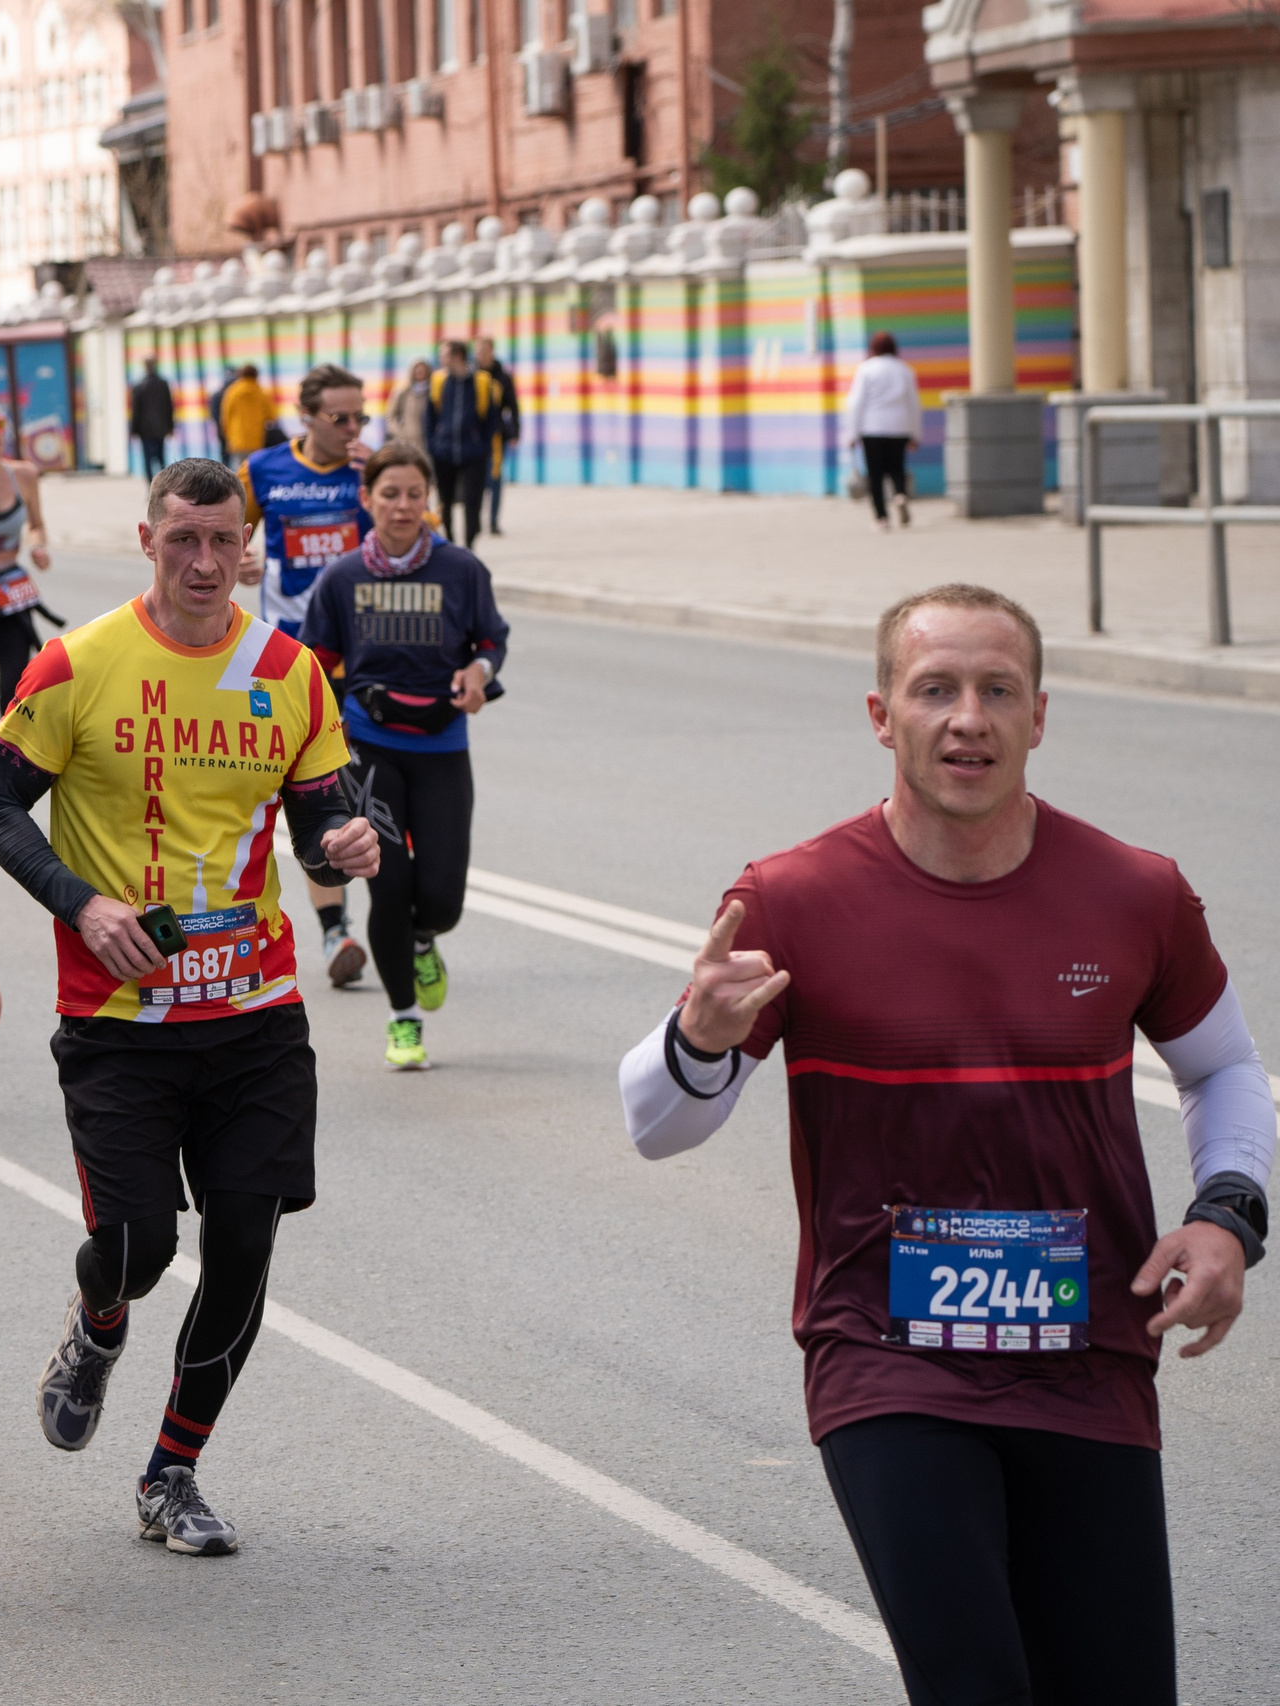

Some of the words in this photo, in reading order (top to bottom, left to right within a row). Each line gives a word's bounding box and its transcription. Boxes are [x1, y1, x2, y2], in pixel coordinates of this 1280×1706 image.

[354, 582, 443, 613] PUMA
[114, 717, 286, 761] SAMARA
[174, 757, 284, 774] INTERNATIONAL
[141, 679, 167, 912] MARATH
[183, 915, 224, 925] ПРОСТО
[181, 921, 225, 932] ОСМОС
[240, 943, 249, 955] D
[168, 944, 235, 984] 1687
[1072, 963, 1099, 972] NIKE
[1057, 973, 1110, 983] RUNNING
[950, 1217, 962, 1227] Я
[963, 1218, 1030, 1229] ПРОСТО
[950, 1228, 1030, 1239] КОСМОС
[969, 1247, 1004, 1260] ИЛЬЯ
[929, 1265, 1053, 1318] 2244
